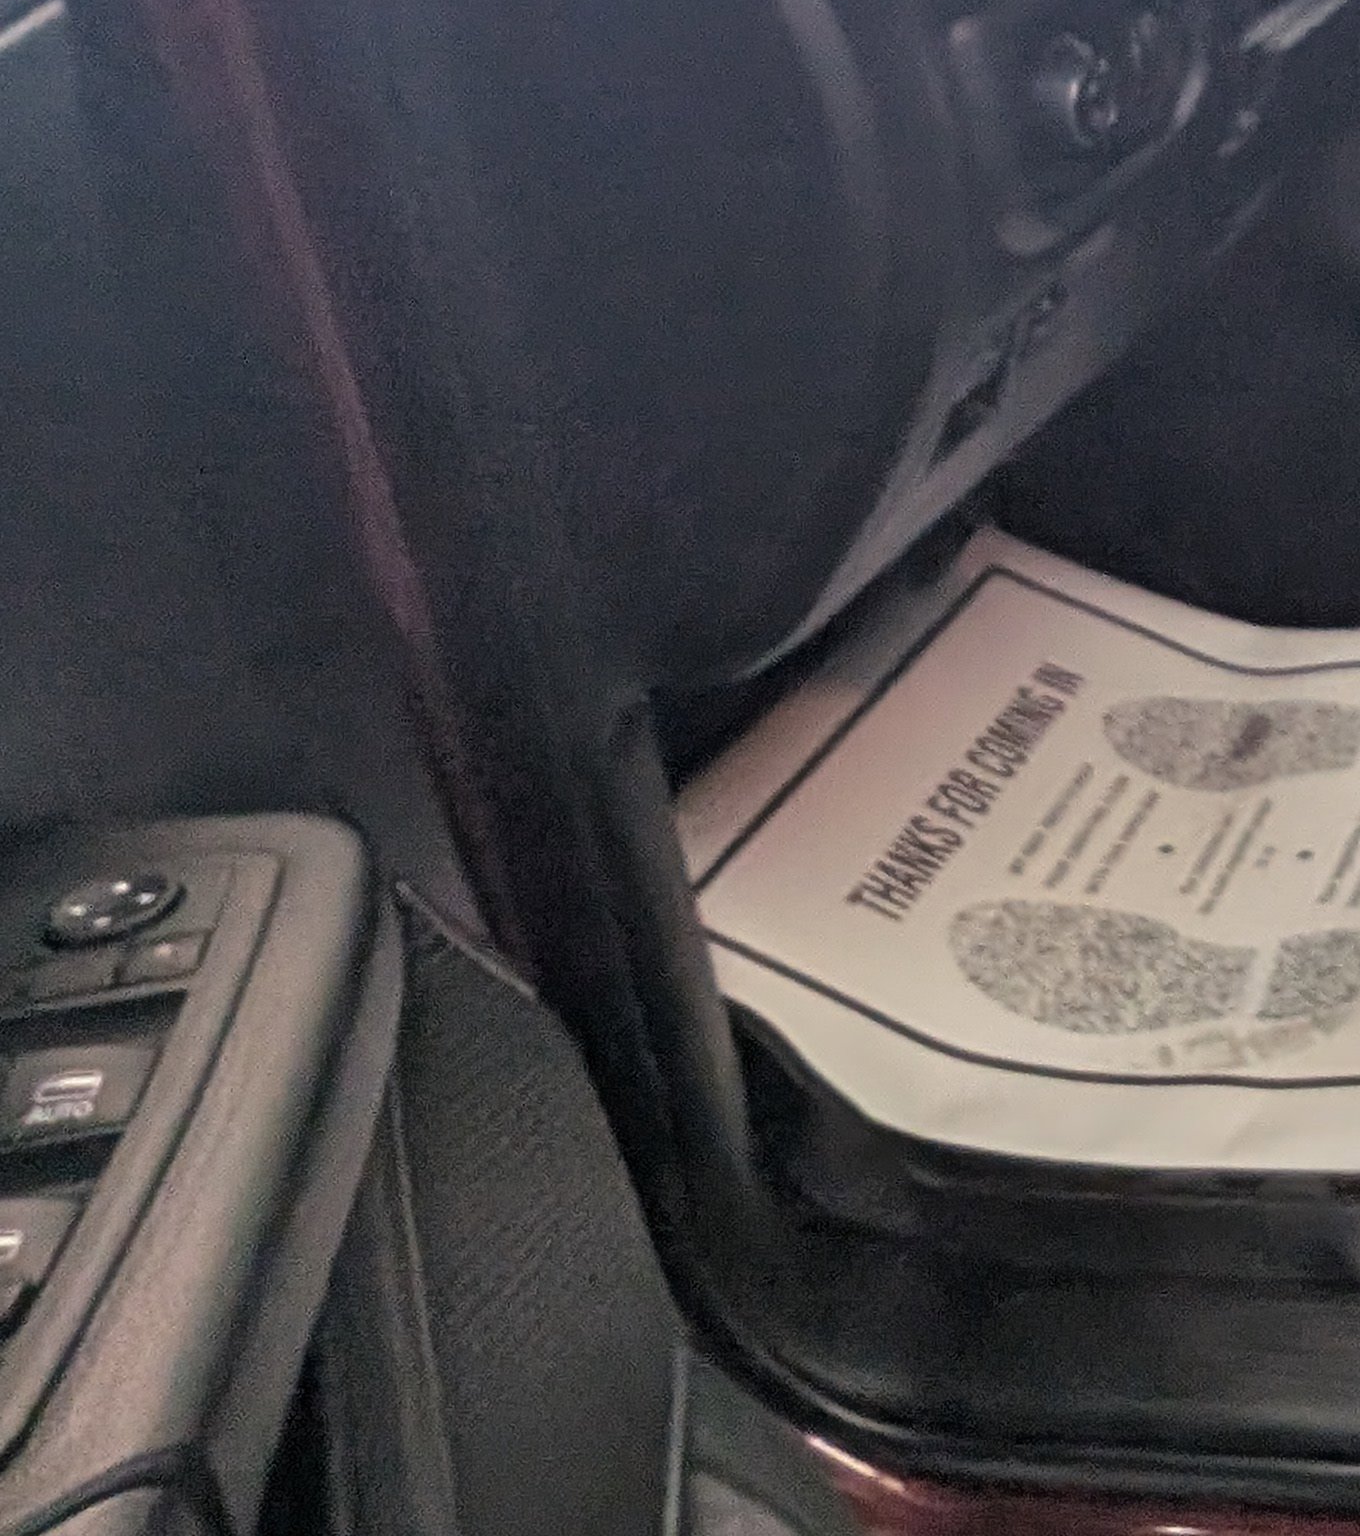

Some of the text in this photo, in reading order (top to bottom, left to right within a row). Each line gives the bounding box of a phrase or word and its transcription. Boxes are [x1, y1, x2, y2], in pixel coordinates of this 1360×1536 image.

[846, 814, 963, 921] THANKS
[925, 767, 1001, 829] FOR
[964, 685, 1066, 778] COMING
[1033, 662, 1085, 696] IN
